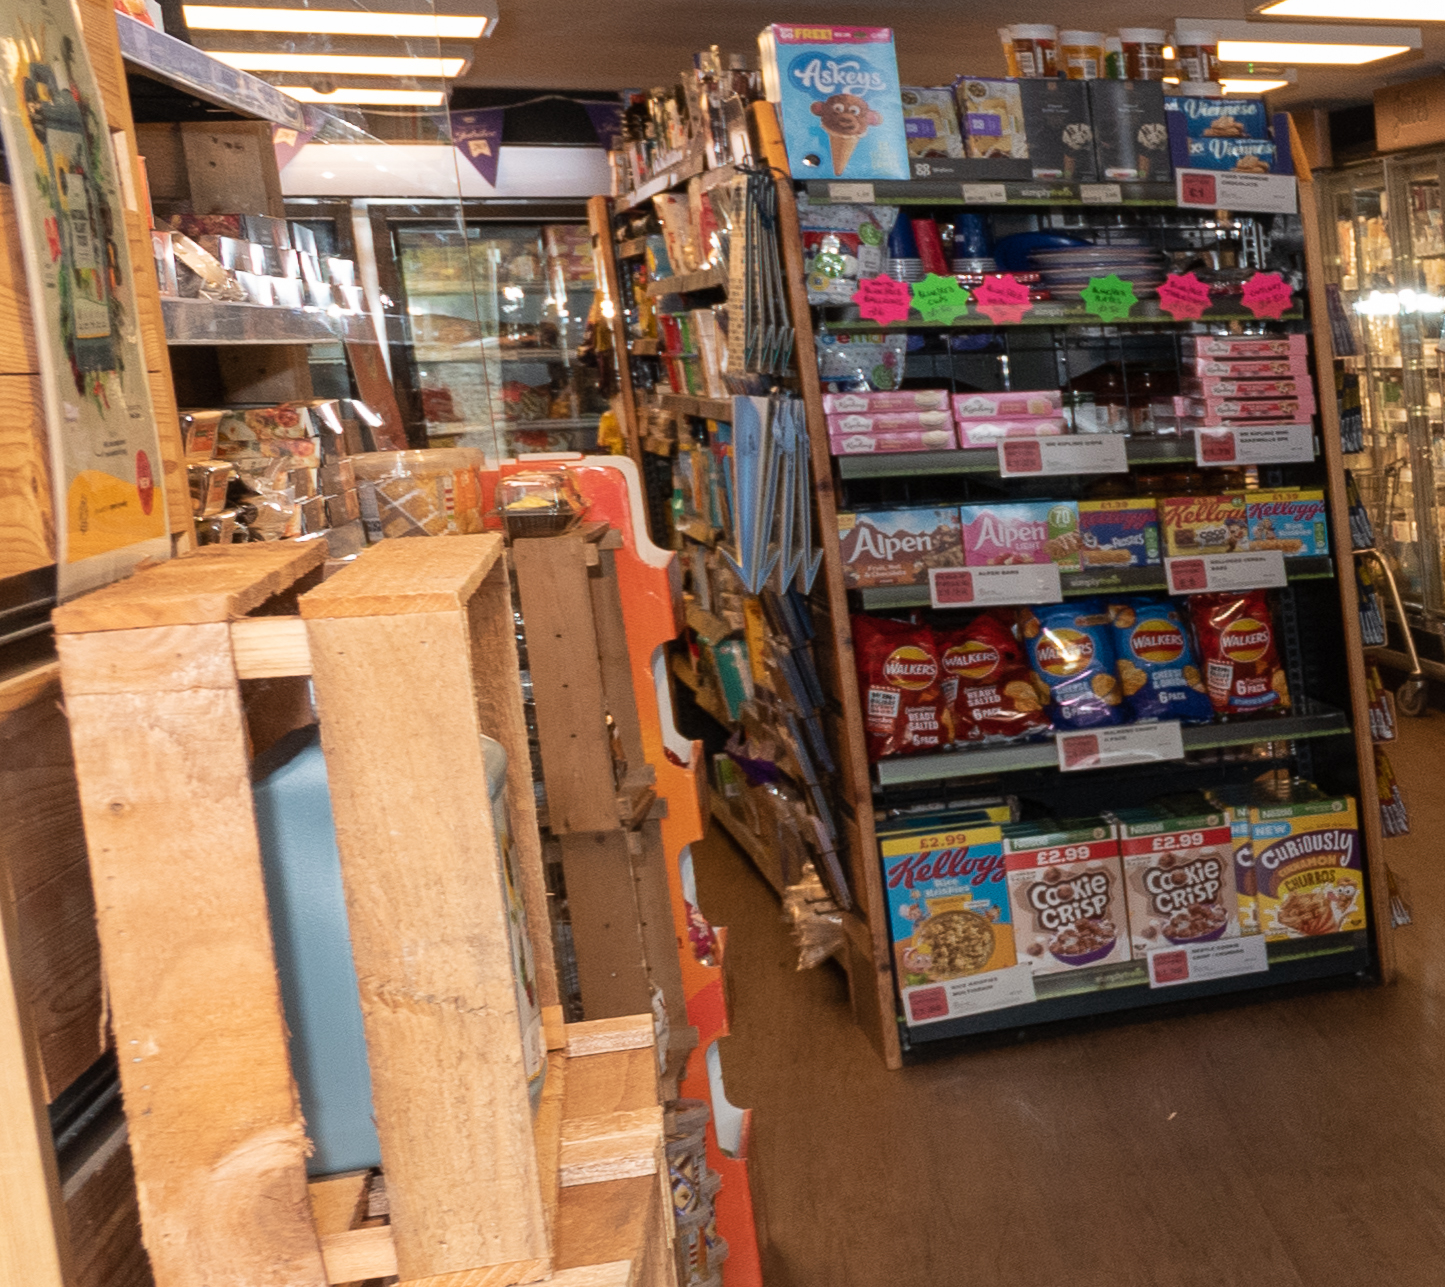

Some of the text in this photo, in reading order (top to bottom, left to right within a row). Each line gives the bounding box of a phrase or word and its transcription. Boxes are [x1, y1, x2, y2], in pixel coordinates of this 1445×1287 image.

[794, 58, 887, 97] Askeys
[1184, 98, 1258, 119] Viennese
[973, 516, 1046, 552] Alpen
[846, 526, 933, 564] Alpen
[1131, 633, 1184, 650] WALKERS
[885, 662, 938, 678] WALKERS
[1253, 823, 1287, 838] NEW
[1151, 832, 1205, 851] £2.99
[1036, 846, 1091, 866] £2.99
[1284, 869, 1337, 893] CHURROS
